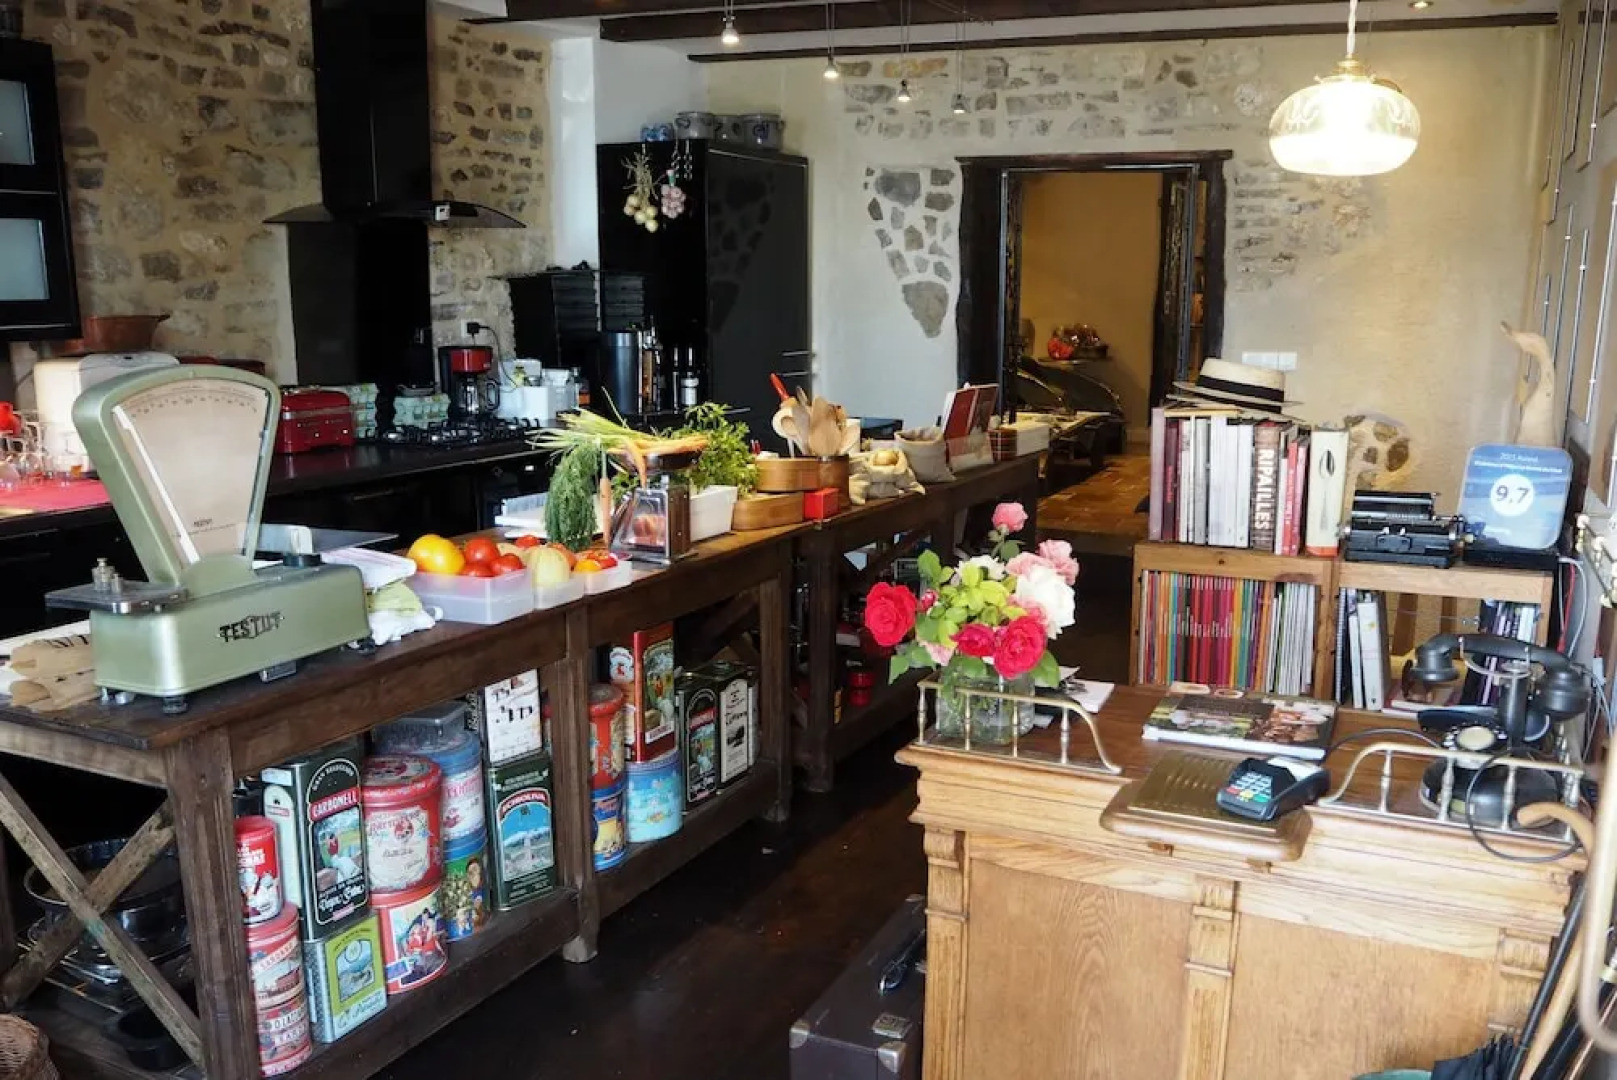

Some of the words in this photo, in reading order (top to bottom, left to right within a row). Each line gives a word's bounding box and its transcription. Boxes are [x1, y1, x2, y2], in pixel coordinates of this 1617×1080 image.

[1255, 448, 1275, 530] RIPAILLES
[219, 611, 281, 643] TESTUT
[313, 790, 357, 818] CARBONELL
